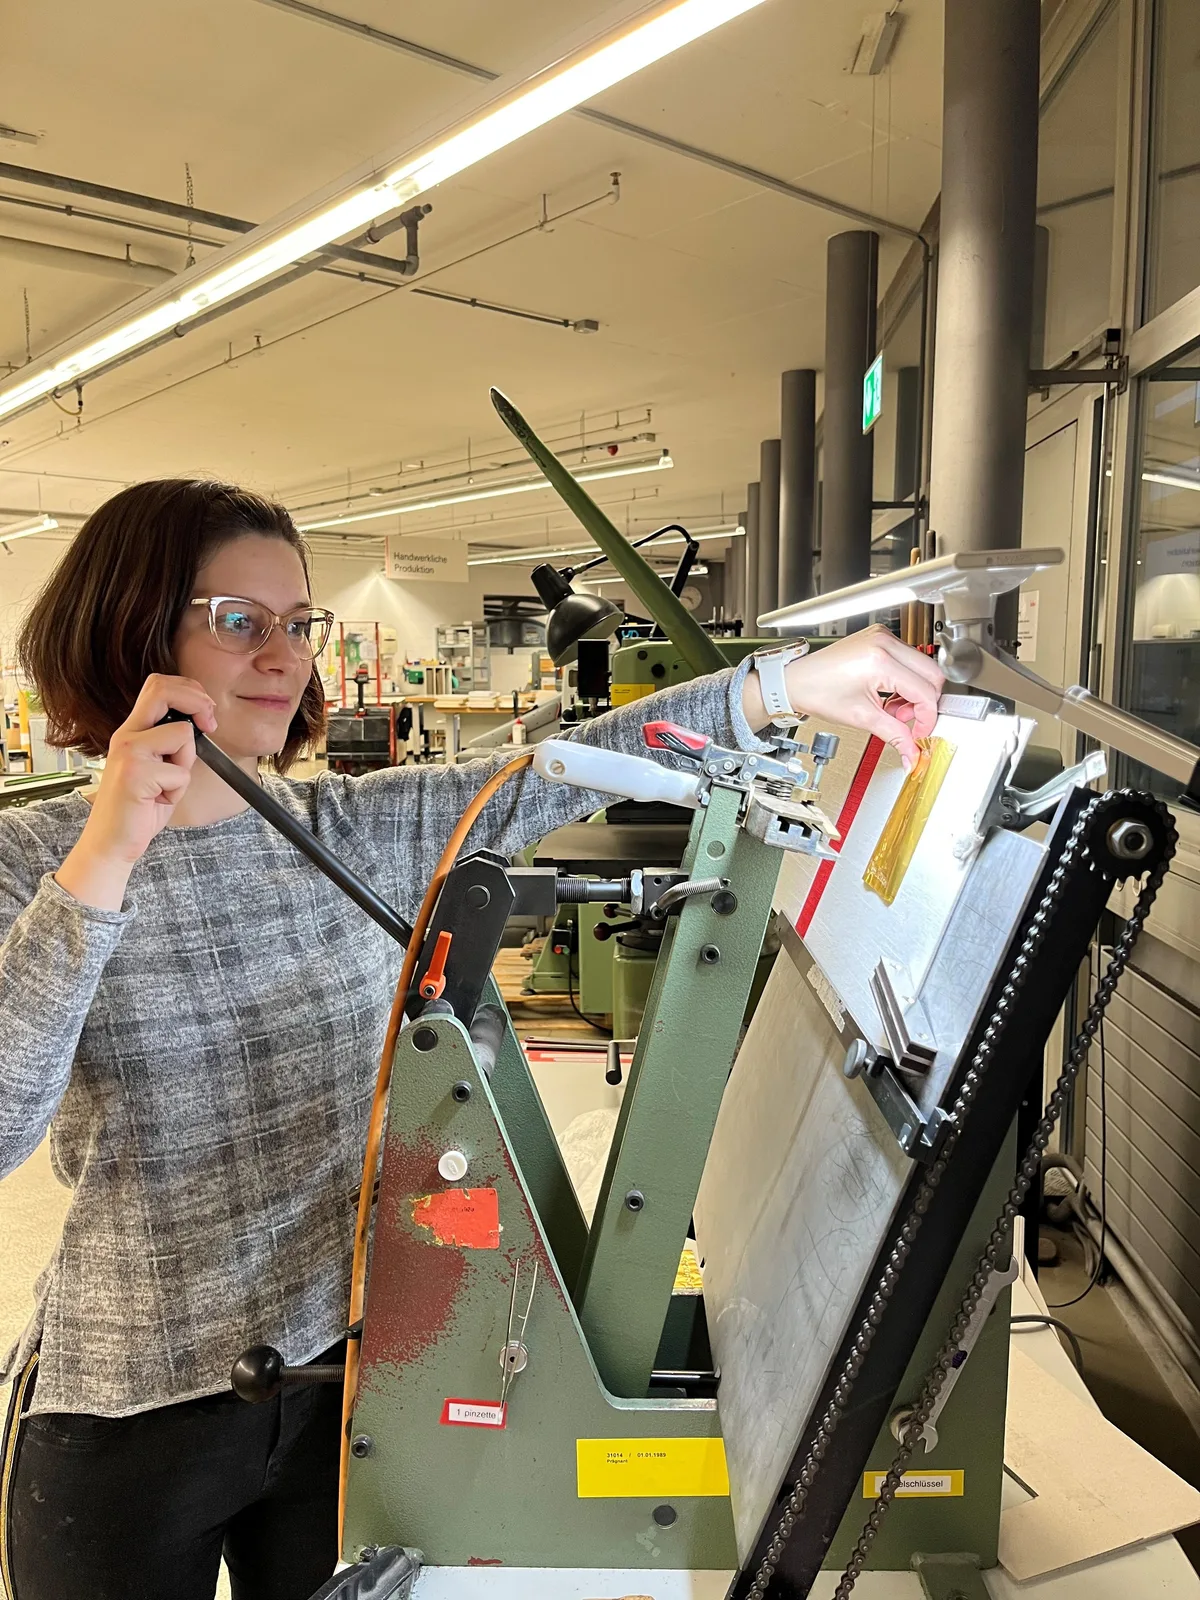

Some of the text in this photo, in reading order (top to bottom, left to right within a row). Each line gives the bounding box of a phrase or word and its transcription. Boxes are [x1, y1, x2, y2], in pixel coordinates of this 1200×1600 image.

[393, 552, 447, 563] Handwerkliche
[394, 564, 434, 574] Produktion
[464, 1411, 497, 1419] pinzette
[881, 1480, 944, 1488] elschlüssel
